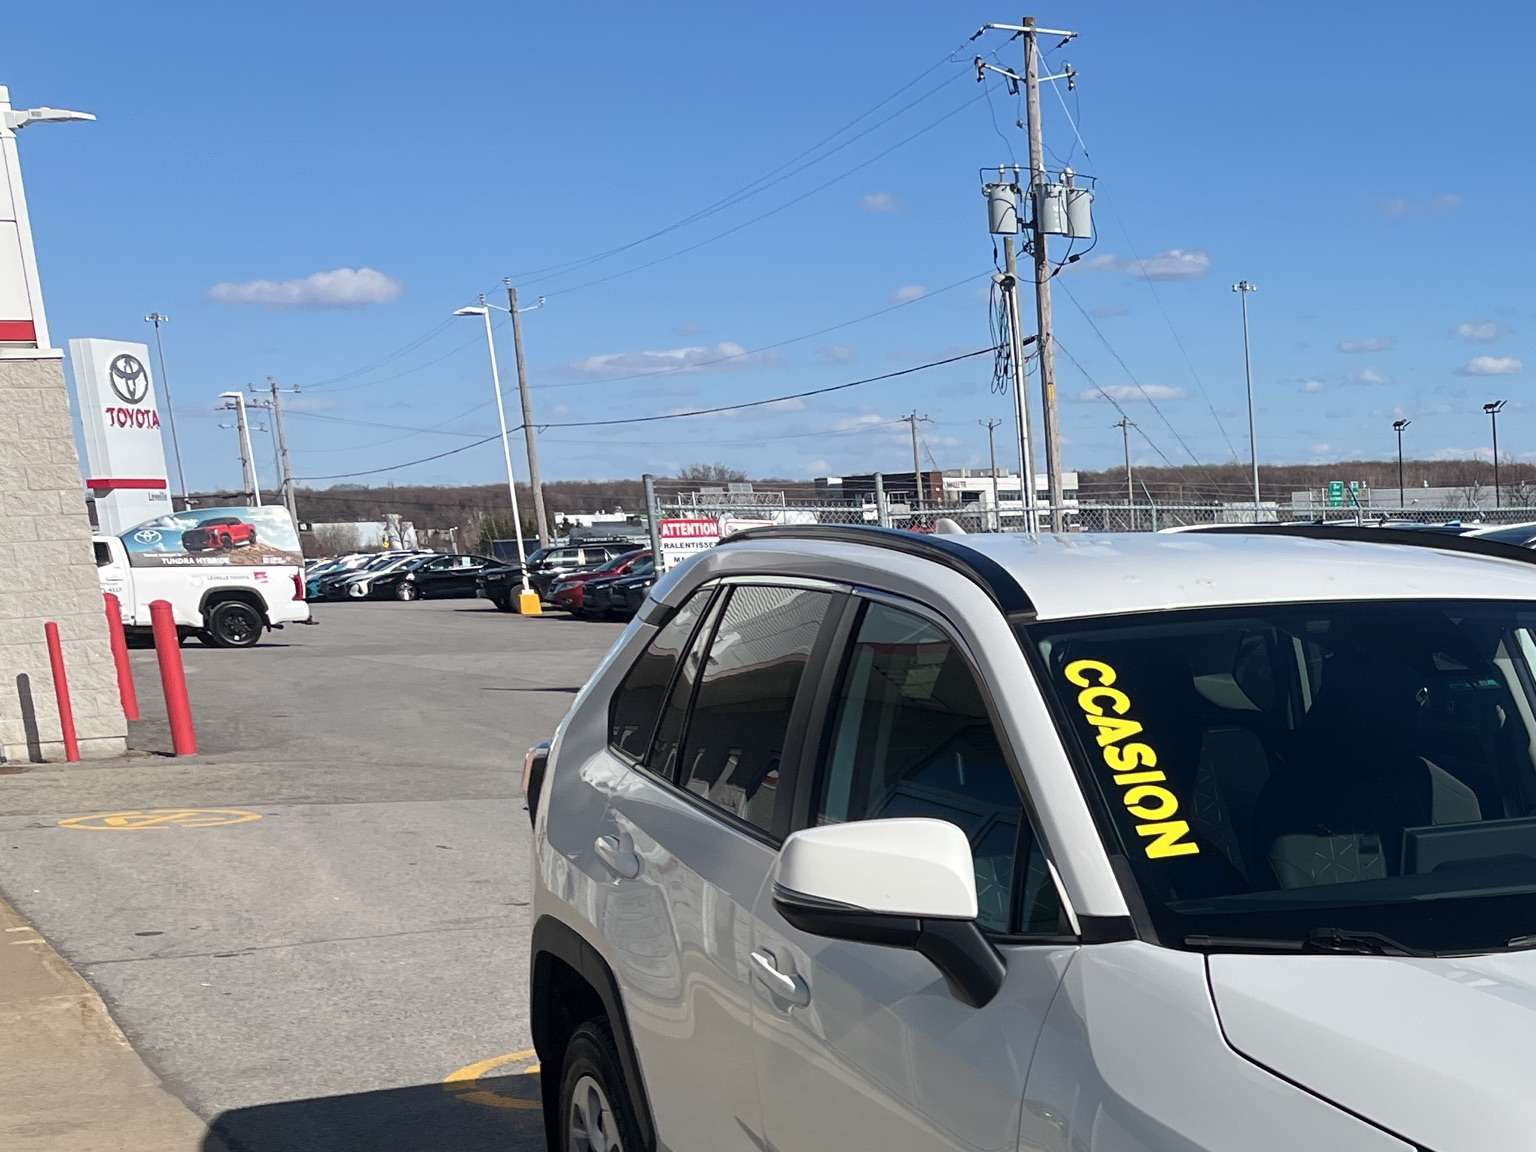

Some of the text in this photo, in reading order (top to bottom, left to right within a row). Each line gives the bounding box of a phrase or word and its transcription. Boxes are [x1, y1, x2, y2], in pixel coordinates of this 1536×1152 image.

[105, 407, 161, 429] TOYOTA
[662, 522, 718, 537] ATTENTION
[663, 541, 718, 549] RALENTISSE
[1064, 659, 1200, 859] CCASION
